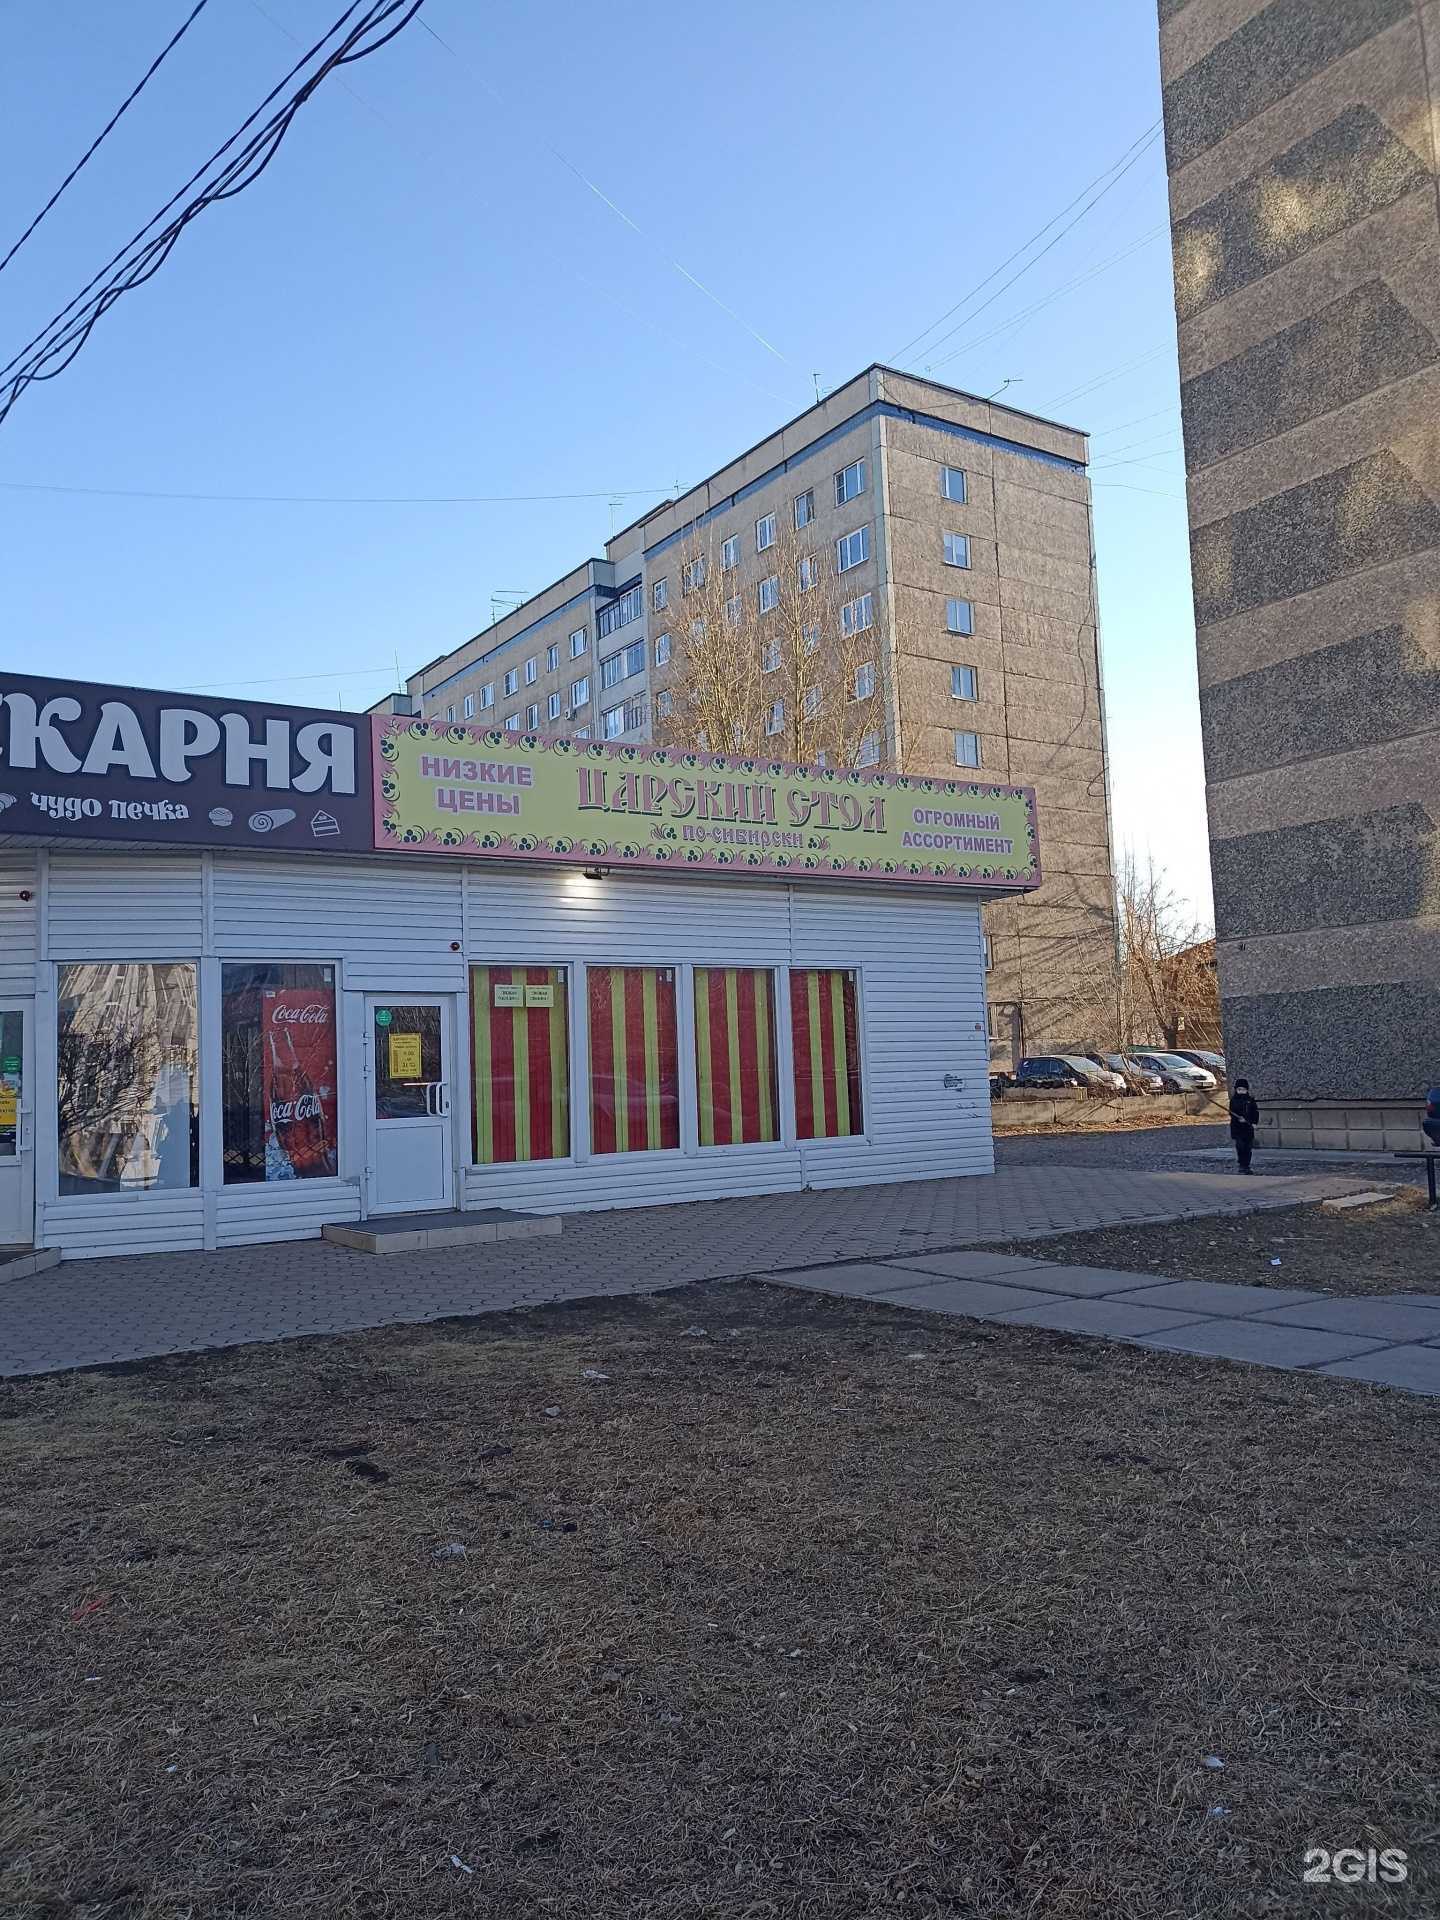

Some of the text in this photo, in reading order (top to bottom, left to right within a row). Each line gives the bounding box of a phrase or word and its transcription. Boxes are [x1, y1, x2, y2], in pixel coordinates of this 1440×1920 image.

[0, 691, 355, 794] КАРНЯ
[421, 755, 533, 787] НИЗКИЕ
[30, 791, 191, 821] чудо печка
[437, 787, 521, 815] ЦЕНЫ
[576, 766, 888, 834] ЦАРСКИЙ СТОЛ
[913, 807, 1001, 832] ОГРОМНЫЙ
[902, 830, 1014, 856] АССОРТИМЕНТ
